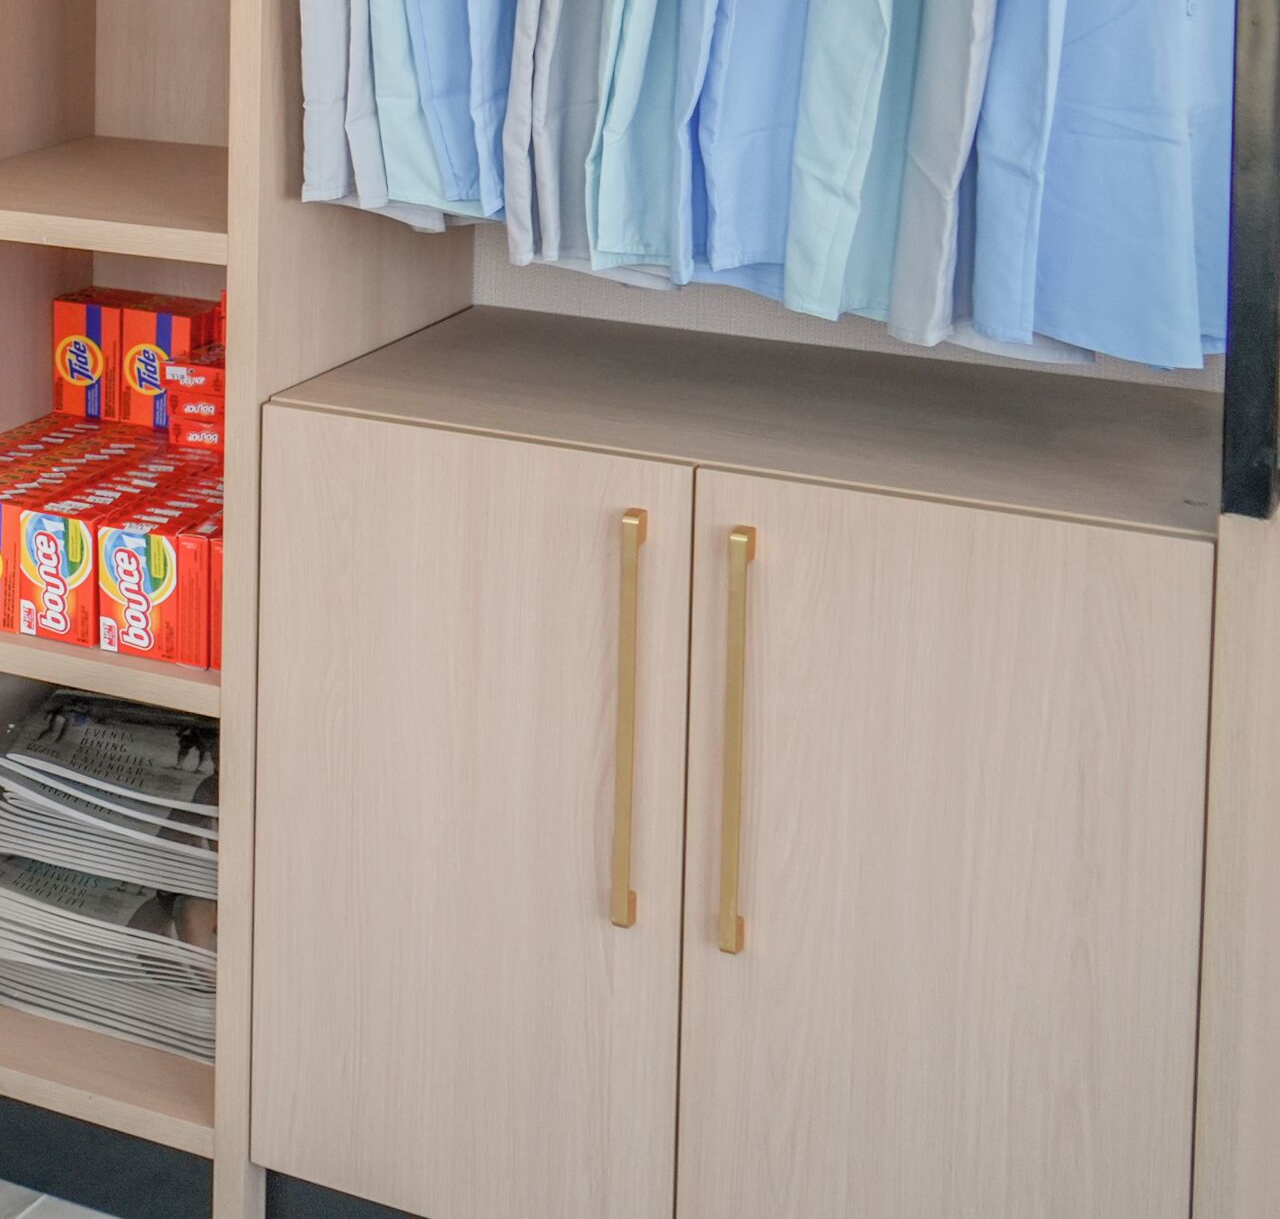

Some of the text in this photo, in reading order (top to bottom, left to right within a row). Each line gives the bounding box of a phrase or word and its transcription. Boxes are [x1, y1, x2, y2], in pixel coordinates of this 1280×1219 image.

[68, 340, 96, 382] Tide
[136, 348, 164, 392] Tide
[184, 404, 215, 415] bounce
[187, 432, 219, 443] bounce
[36, 531, 70, 633] bounce
[115, 548, 154, 649] bounce
[80, 737, 128, 753] DINING
[84, 727, 135, 743] EVENTS
[72, 753, 144, 776] CALENDAR
[77, 745, 154, 767] ACTIVITIES
[70, 760, 109, 778] NIGHT
[17, 872, 88, 897] CALENDAR
[25, 865, 99, 888] ACTIVITIES
